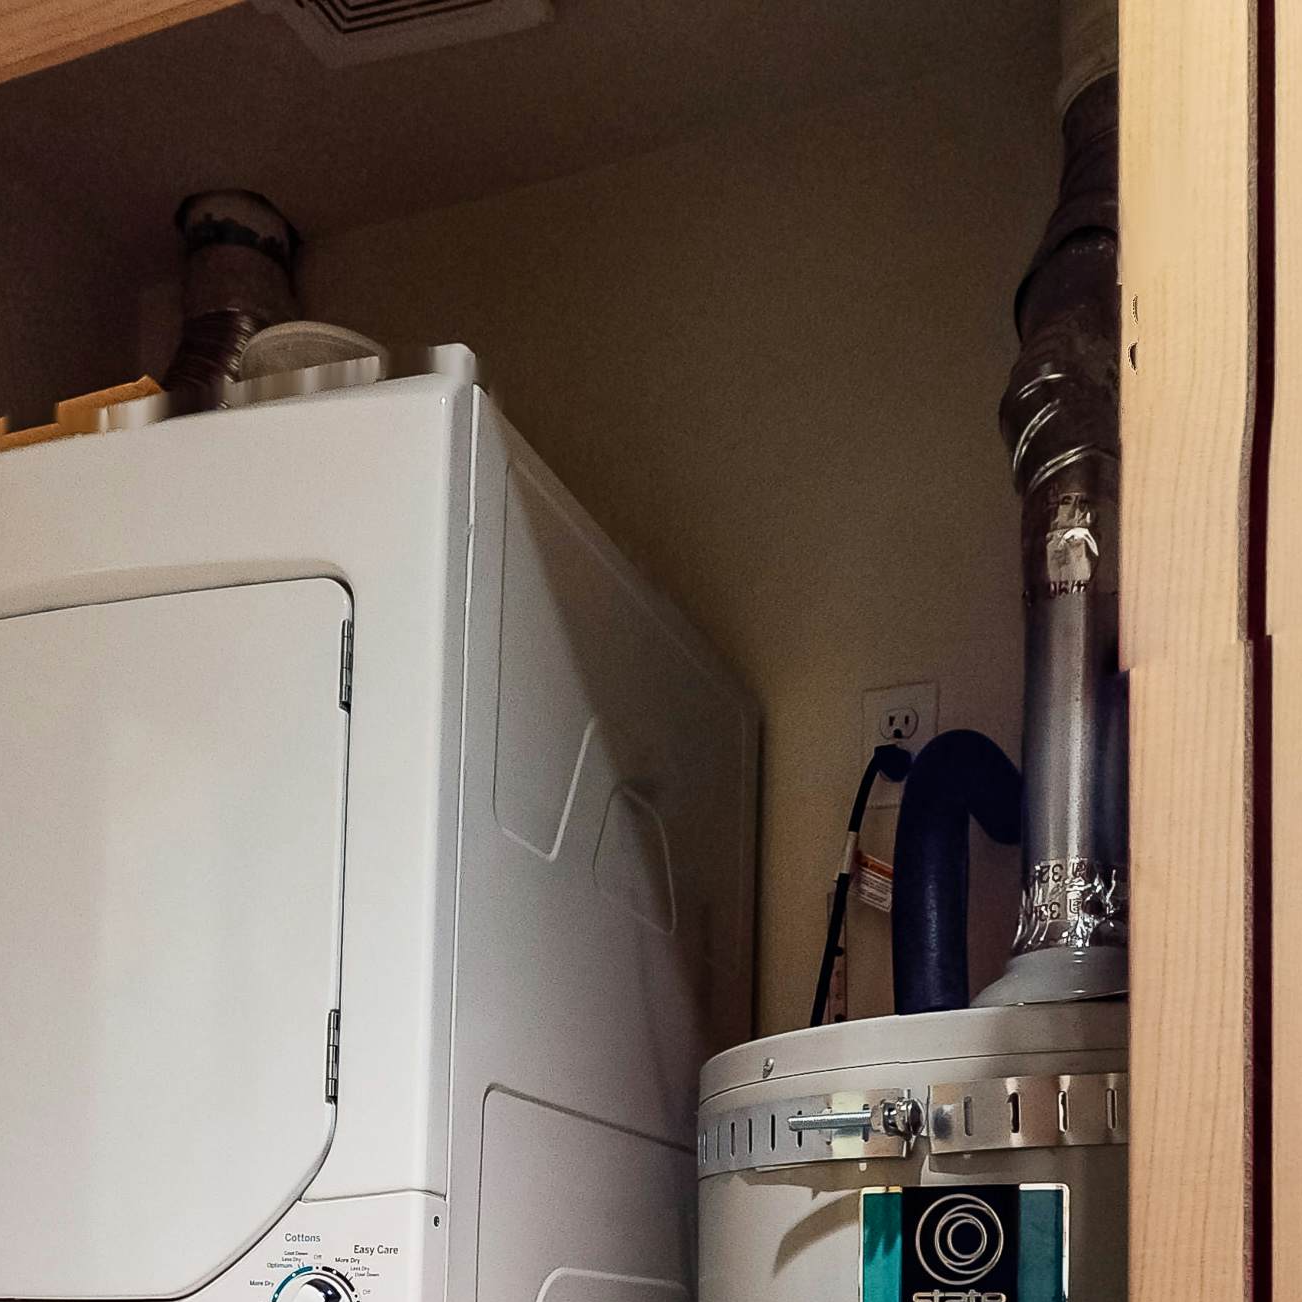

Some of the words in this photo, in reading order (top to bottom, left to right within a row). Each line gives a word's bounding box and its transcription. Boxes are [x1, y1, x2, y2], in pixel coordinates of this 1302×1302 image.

[284, 1233, 321, 1243] Cottons
[353, 1244, 375, 1255] Easy
[377, 1245, 399, 1255] Care
